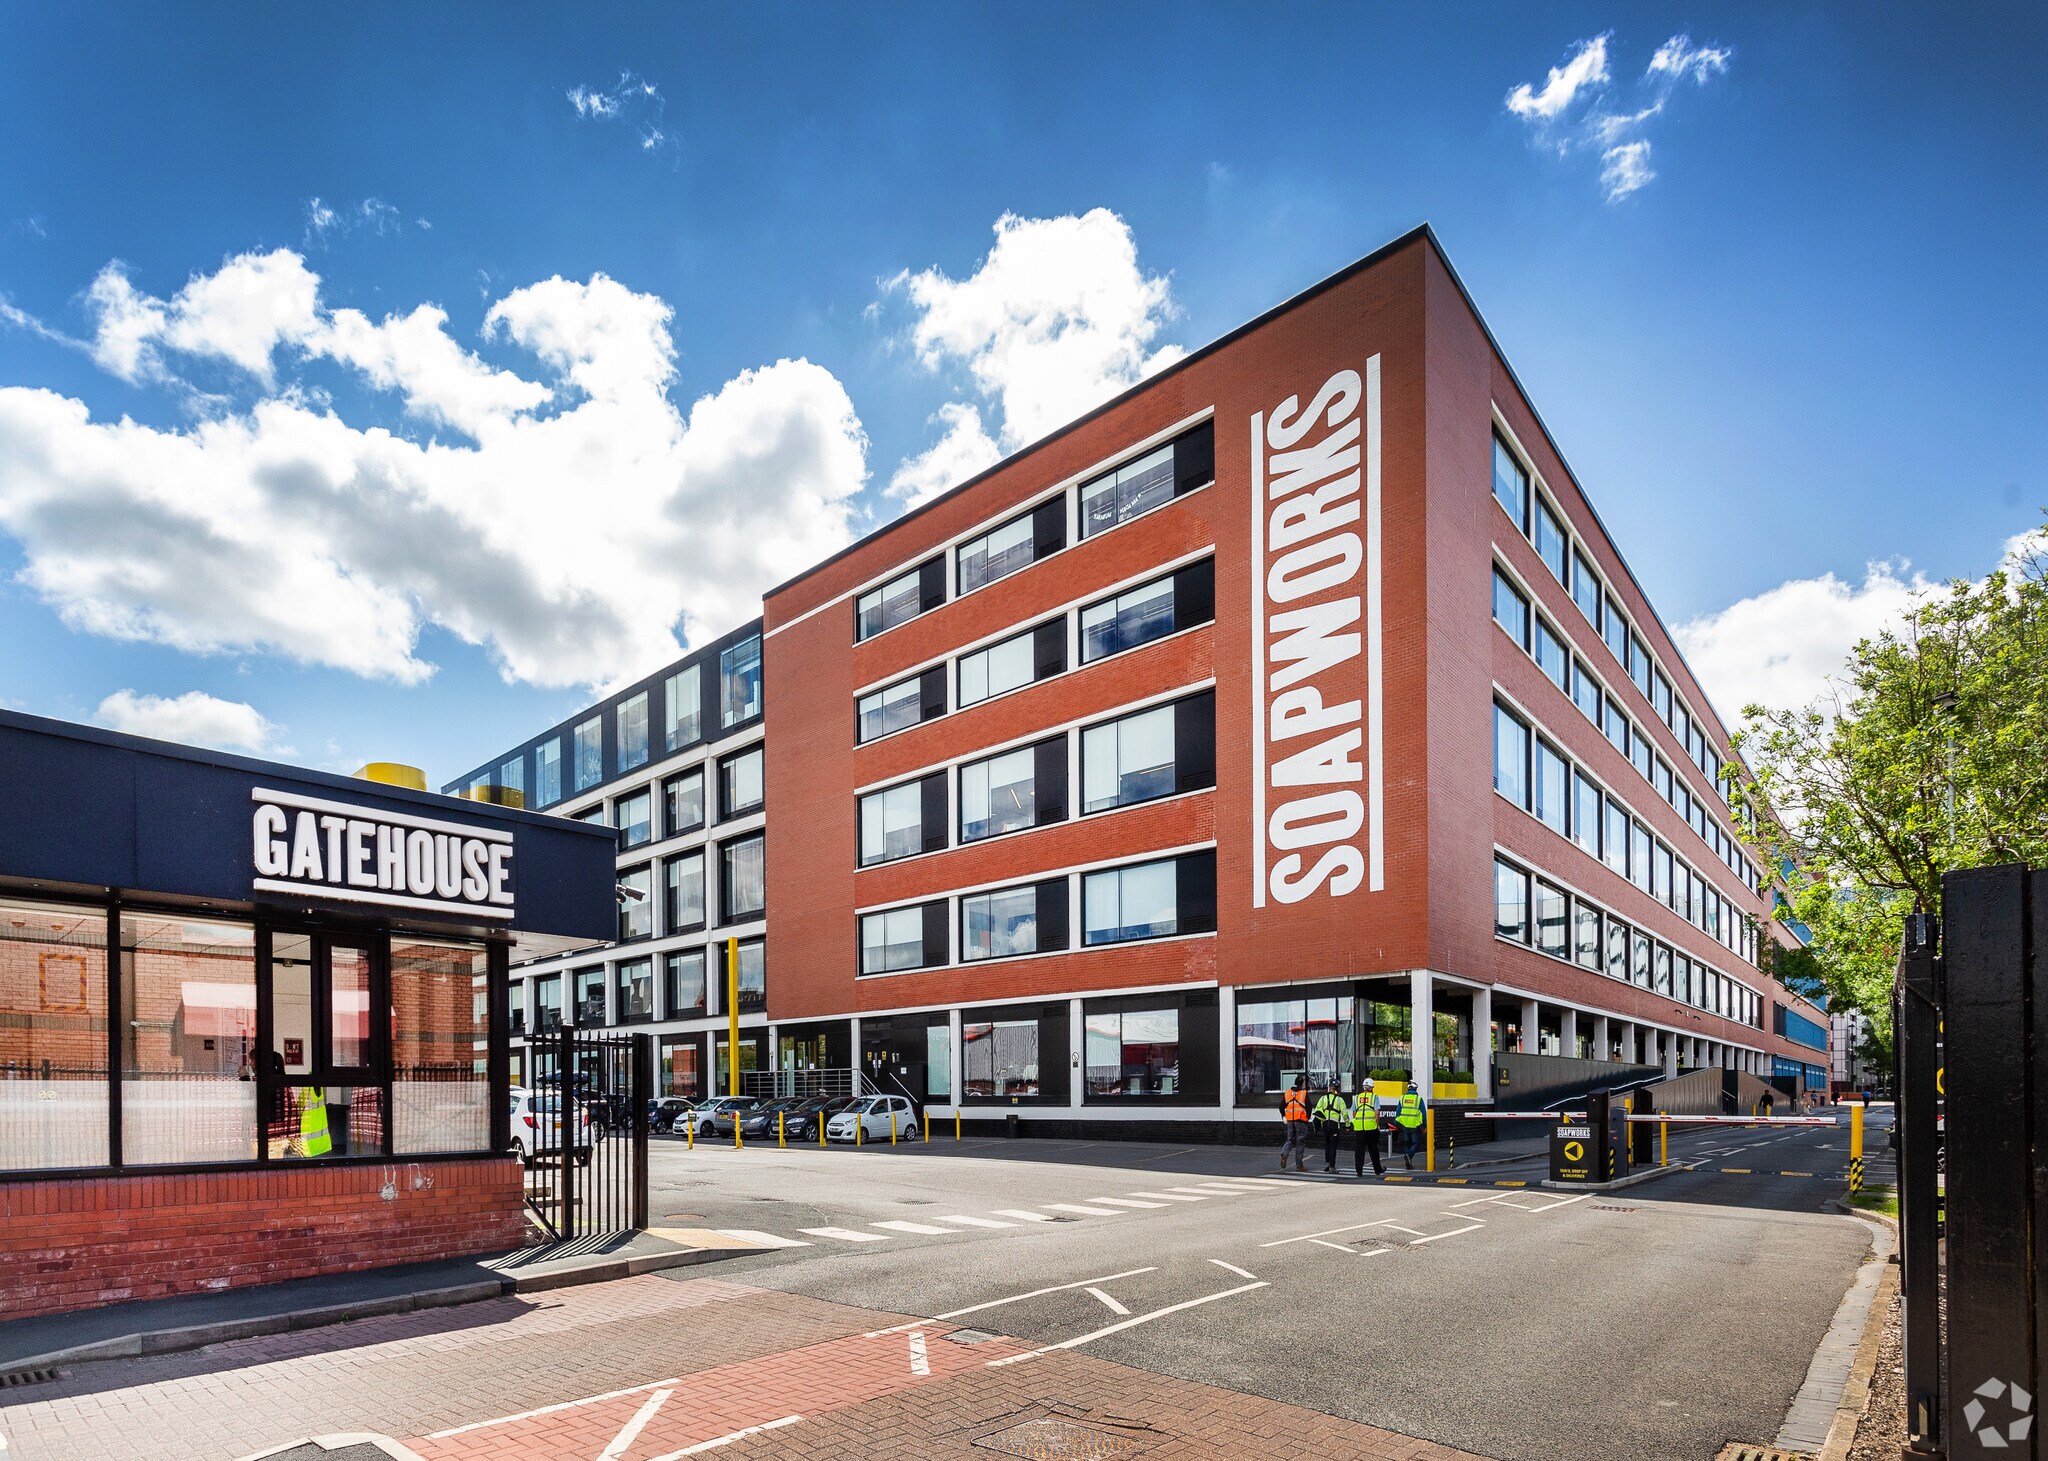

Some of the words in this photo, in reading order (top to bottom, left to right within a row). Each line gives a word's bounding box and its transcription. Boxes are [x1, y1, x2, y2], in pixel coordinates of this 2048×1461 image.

[1266, 369, 1365, 904] SOAPWORKS
[253, 804, 515, 905] GATEHOUSE
[1557, 1127, 1590, 1138] SOAPWORKS
